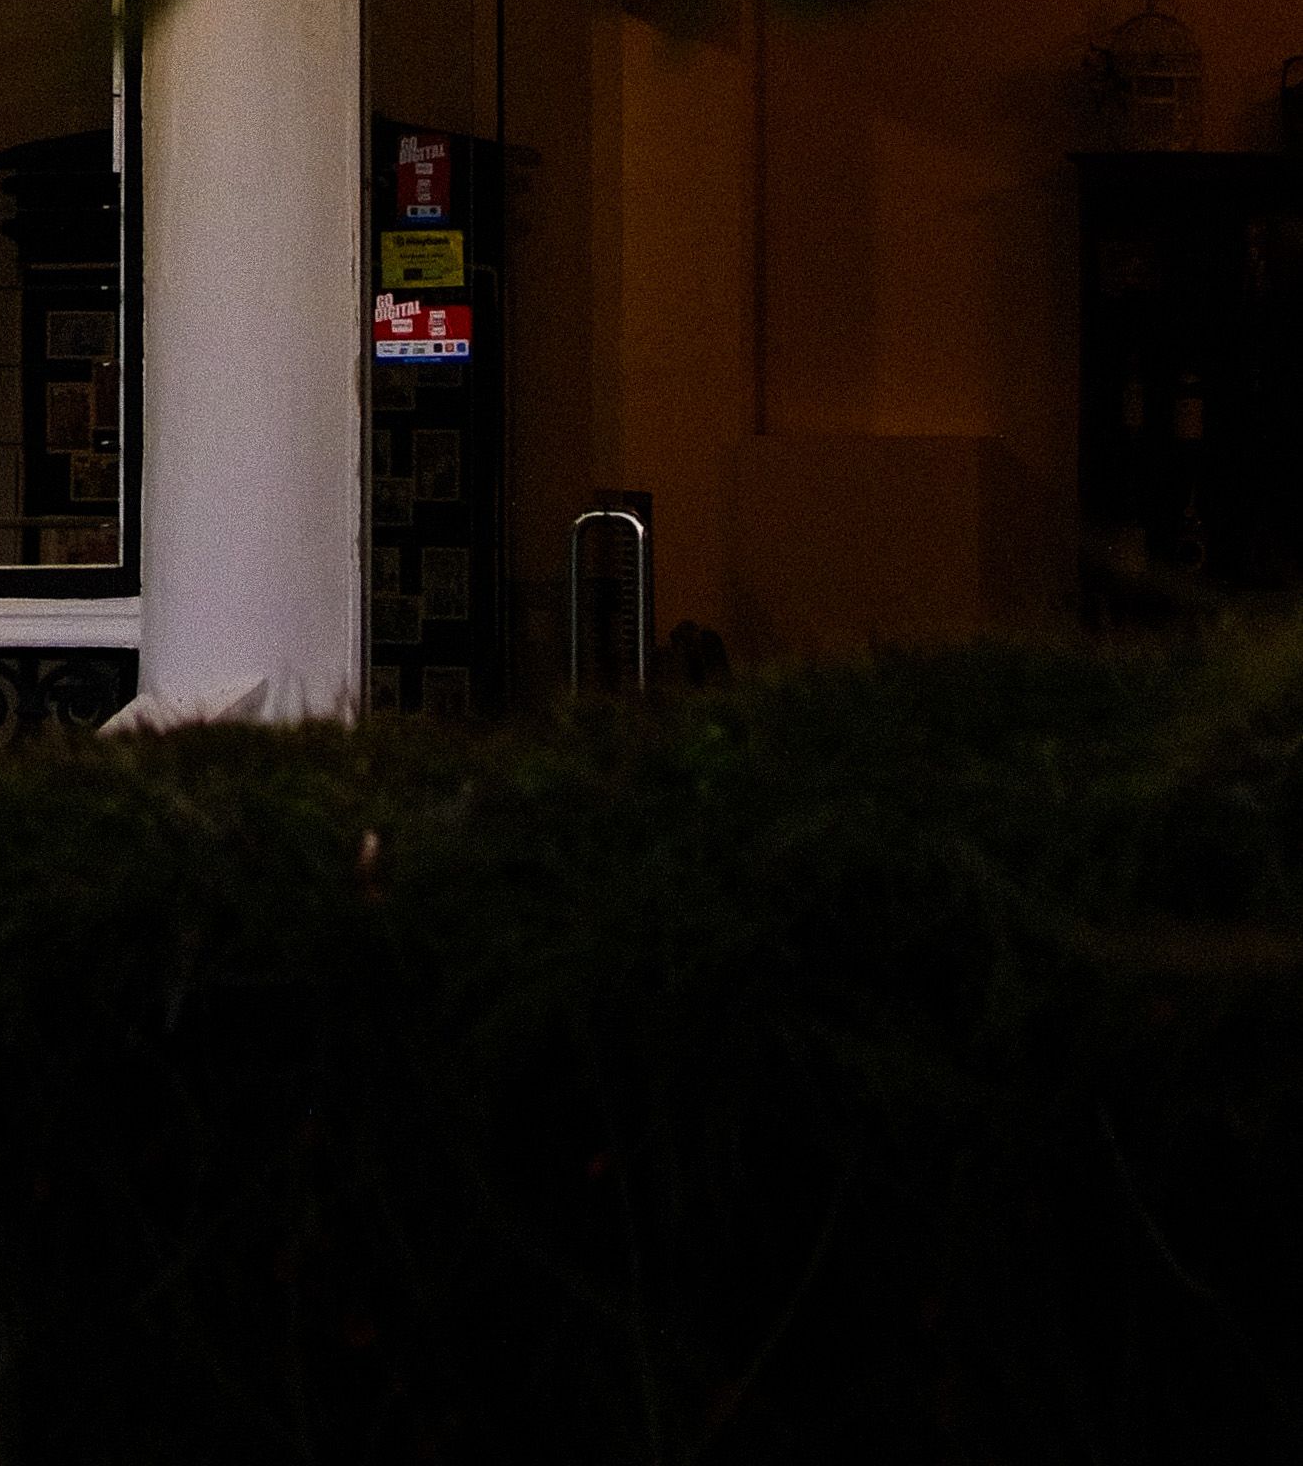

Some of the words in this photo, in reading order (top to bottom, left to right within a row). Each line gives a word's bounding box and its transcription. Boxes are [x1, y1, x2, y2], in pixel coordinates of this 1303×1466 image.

[400, 135, 418, 151] GO
[399, 143, 446, 165] DIGITAL
[376, 292, 394, 308] GO
[374, 299, 423, 323] DIGITAL
